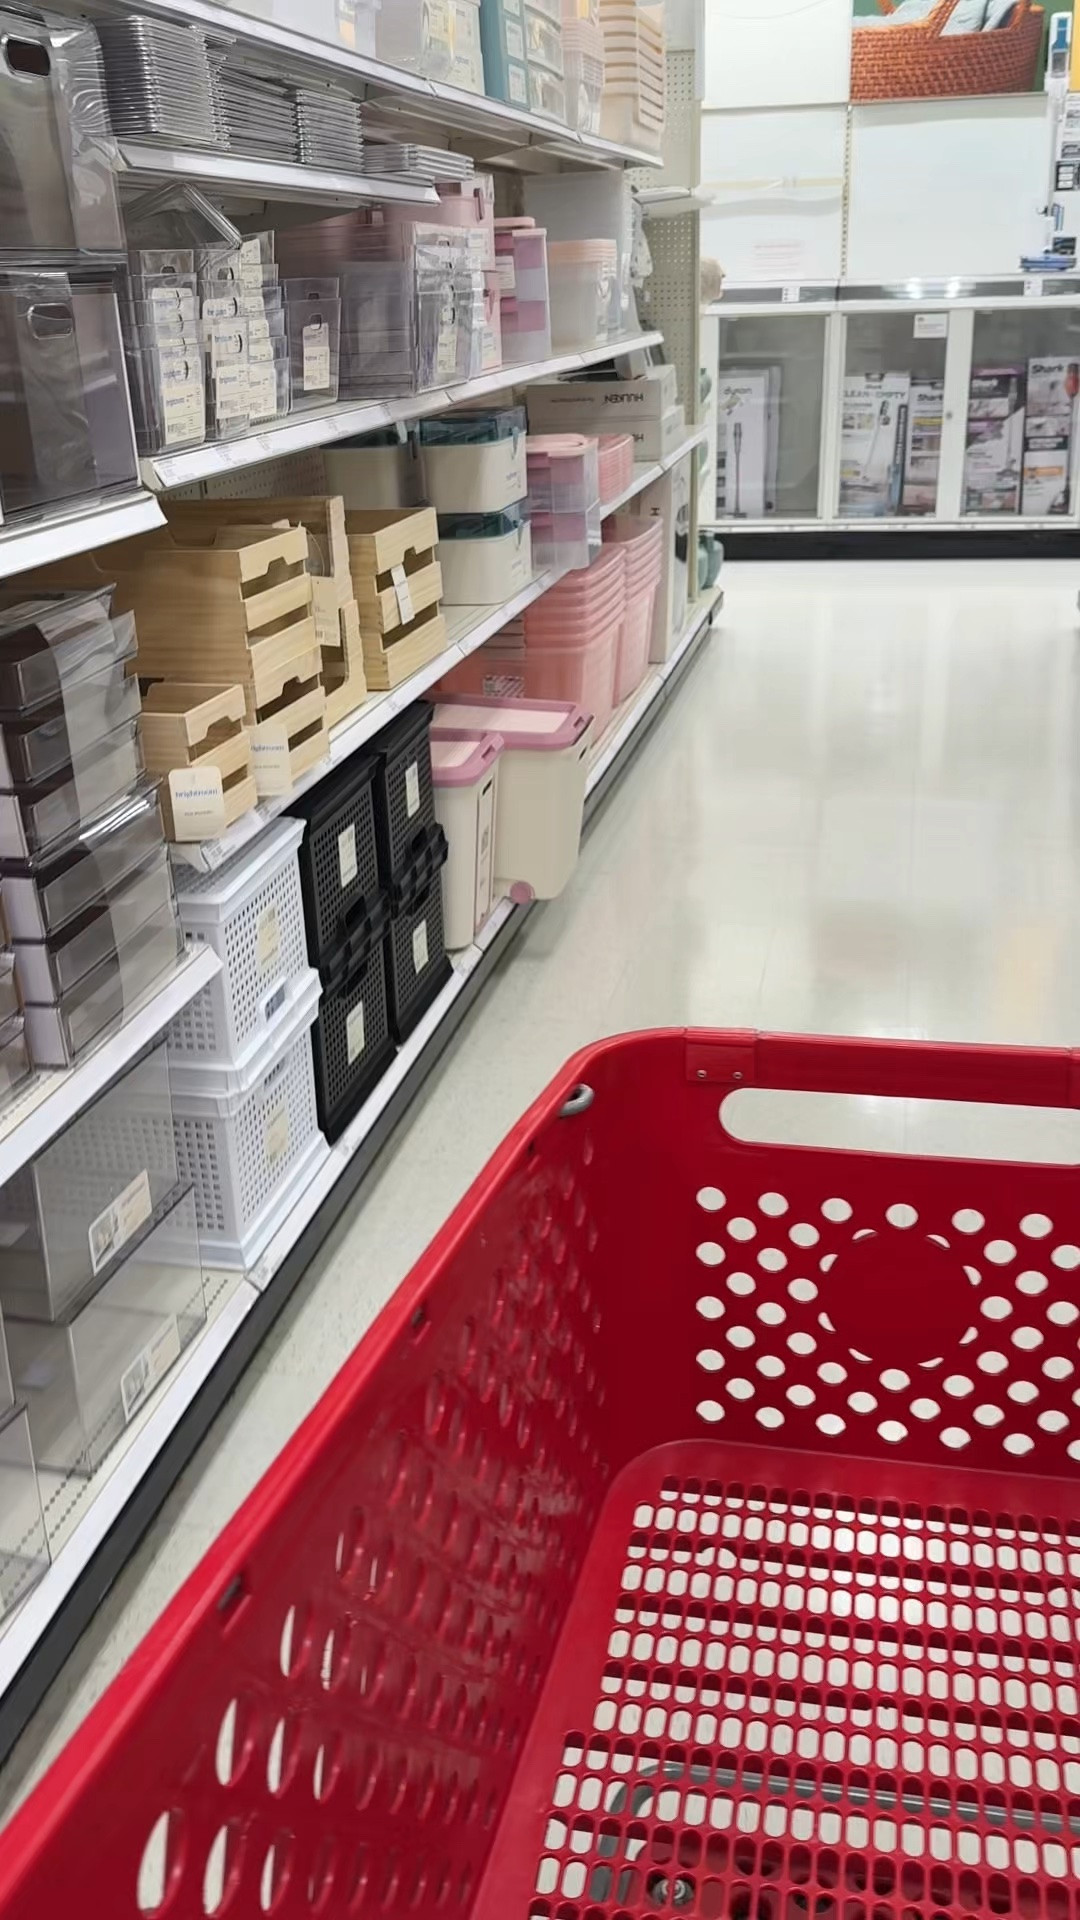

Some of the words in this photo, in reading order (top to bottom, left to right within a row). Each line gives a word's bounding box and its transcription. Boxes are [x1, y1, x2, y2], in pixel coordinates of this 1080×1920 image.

[1032, 364, 1064, 374] Shark
[722, 385, 753, 396] dyson
[175, 788, 218, 799] brightroom
